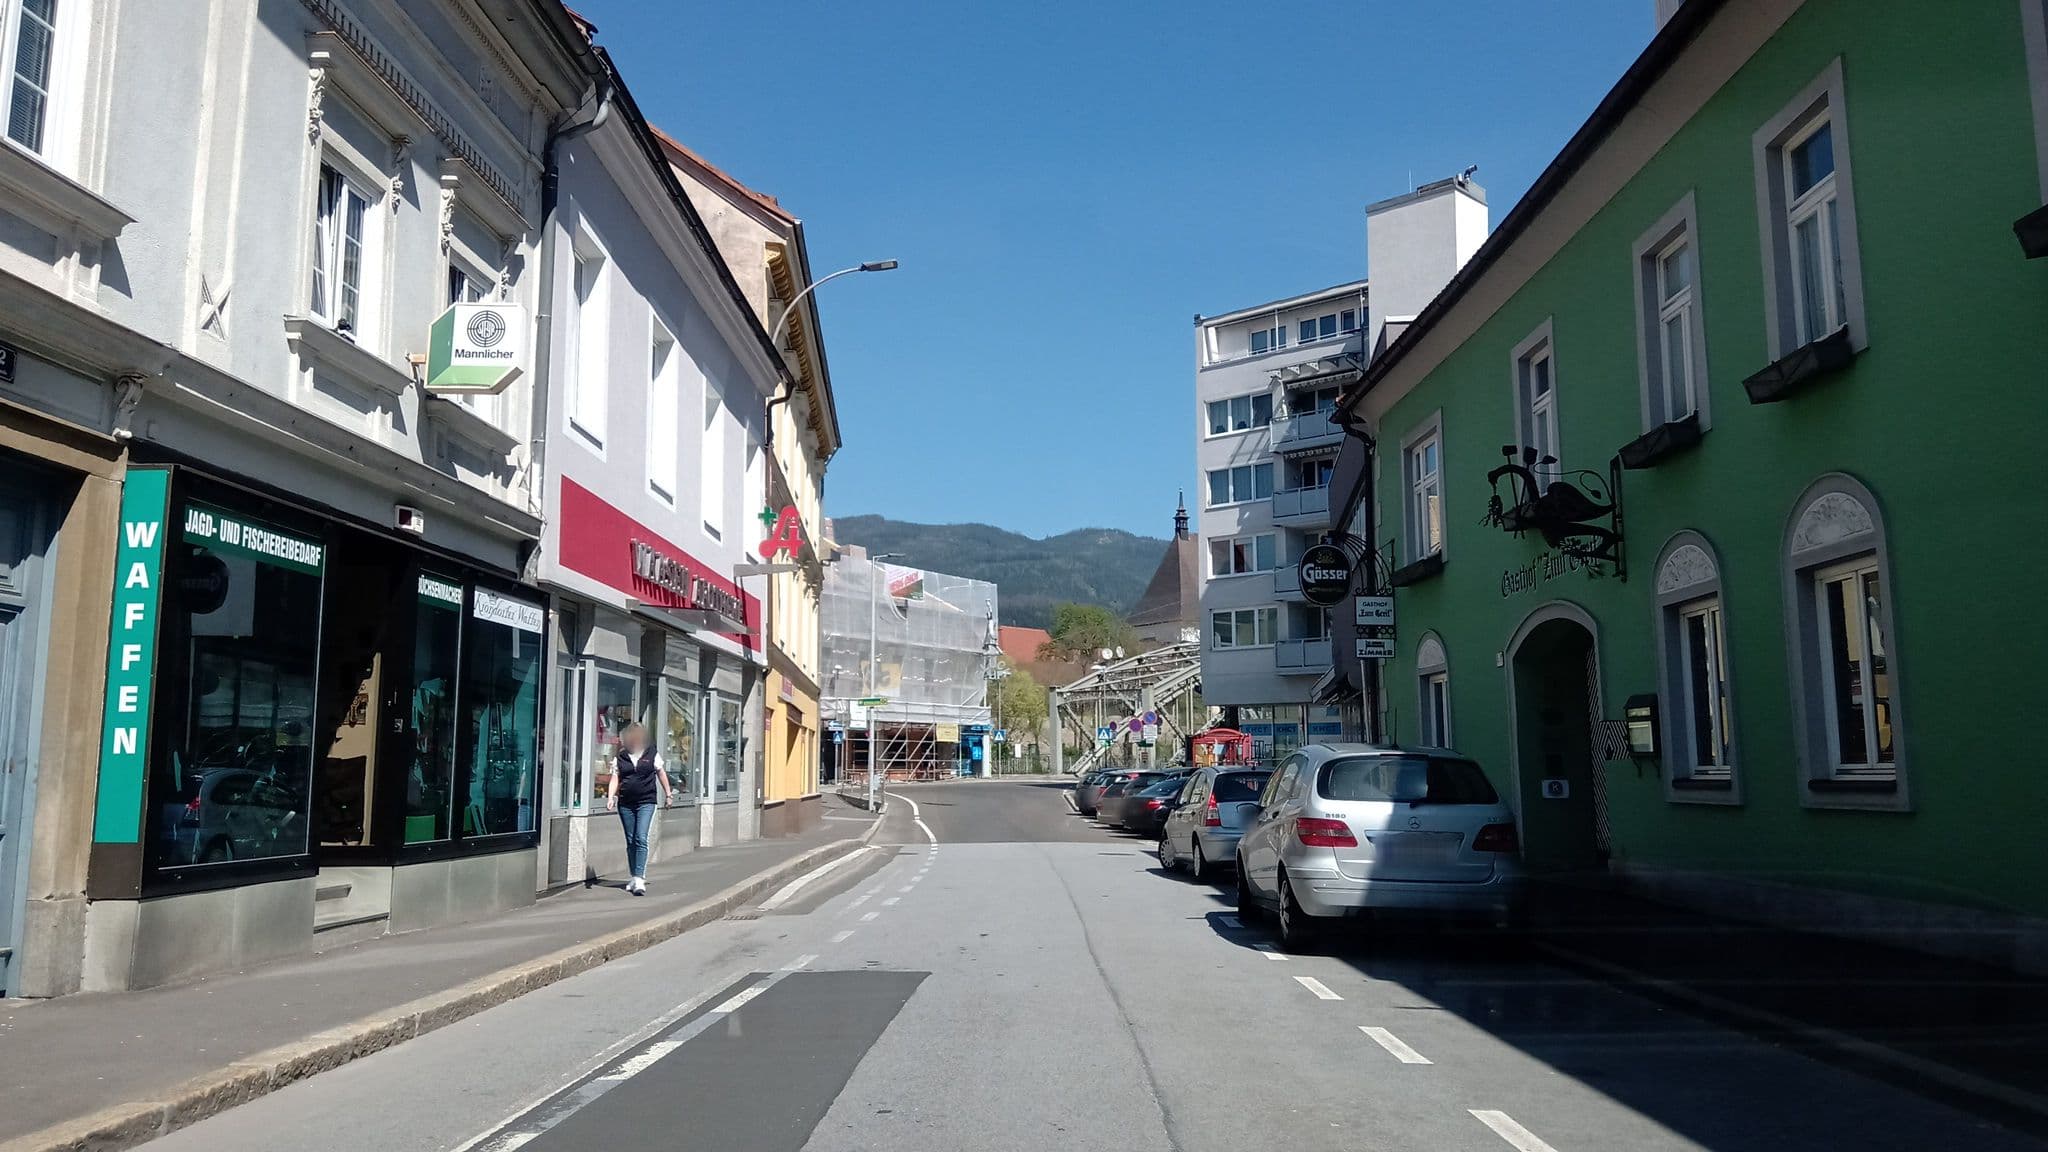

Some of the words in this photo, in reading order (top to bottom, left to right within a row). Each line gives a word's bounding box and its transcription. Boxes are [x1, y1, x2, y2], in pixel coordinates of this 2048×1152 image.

[454, 348, 514, 359] Mannlicher
[185, 509, 217, 537] JAGD-
[219, 519, 240, 545] UND
[242, 525, 322, 567] FISCHEREIBEDARF
[418, 574, 463, 604] ÜCHSENMACHER
[1302, 563, 1348, 583] Gösser
[1501, 557, 1537, 598] Gasthof
[112, 521, 159, 755] WAFFEN
